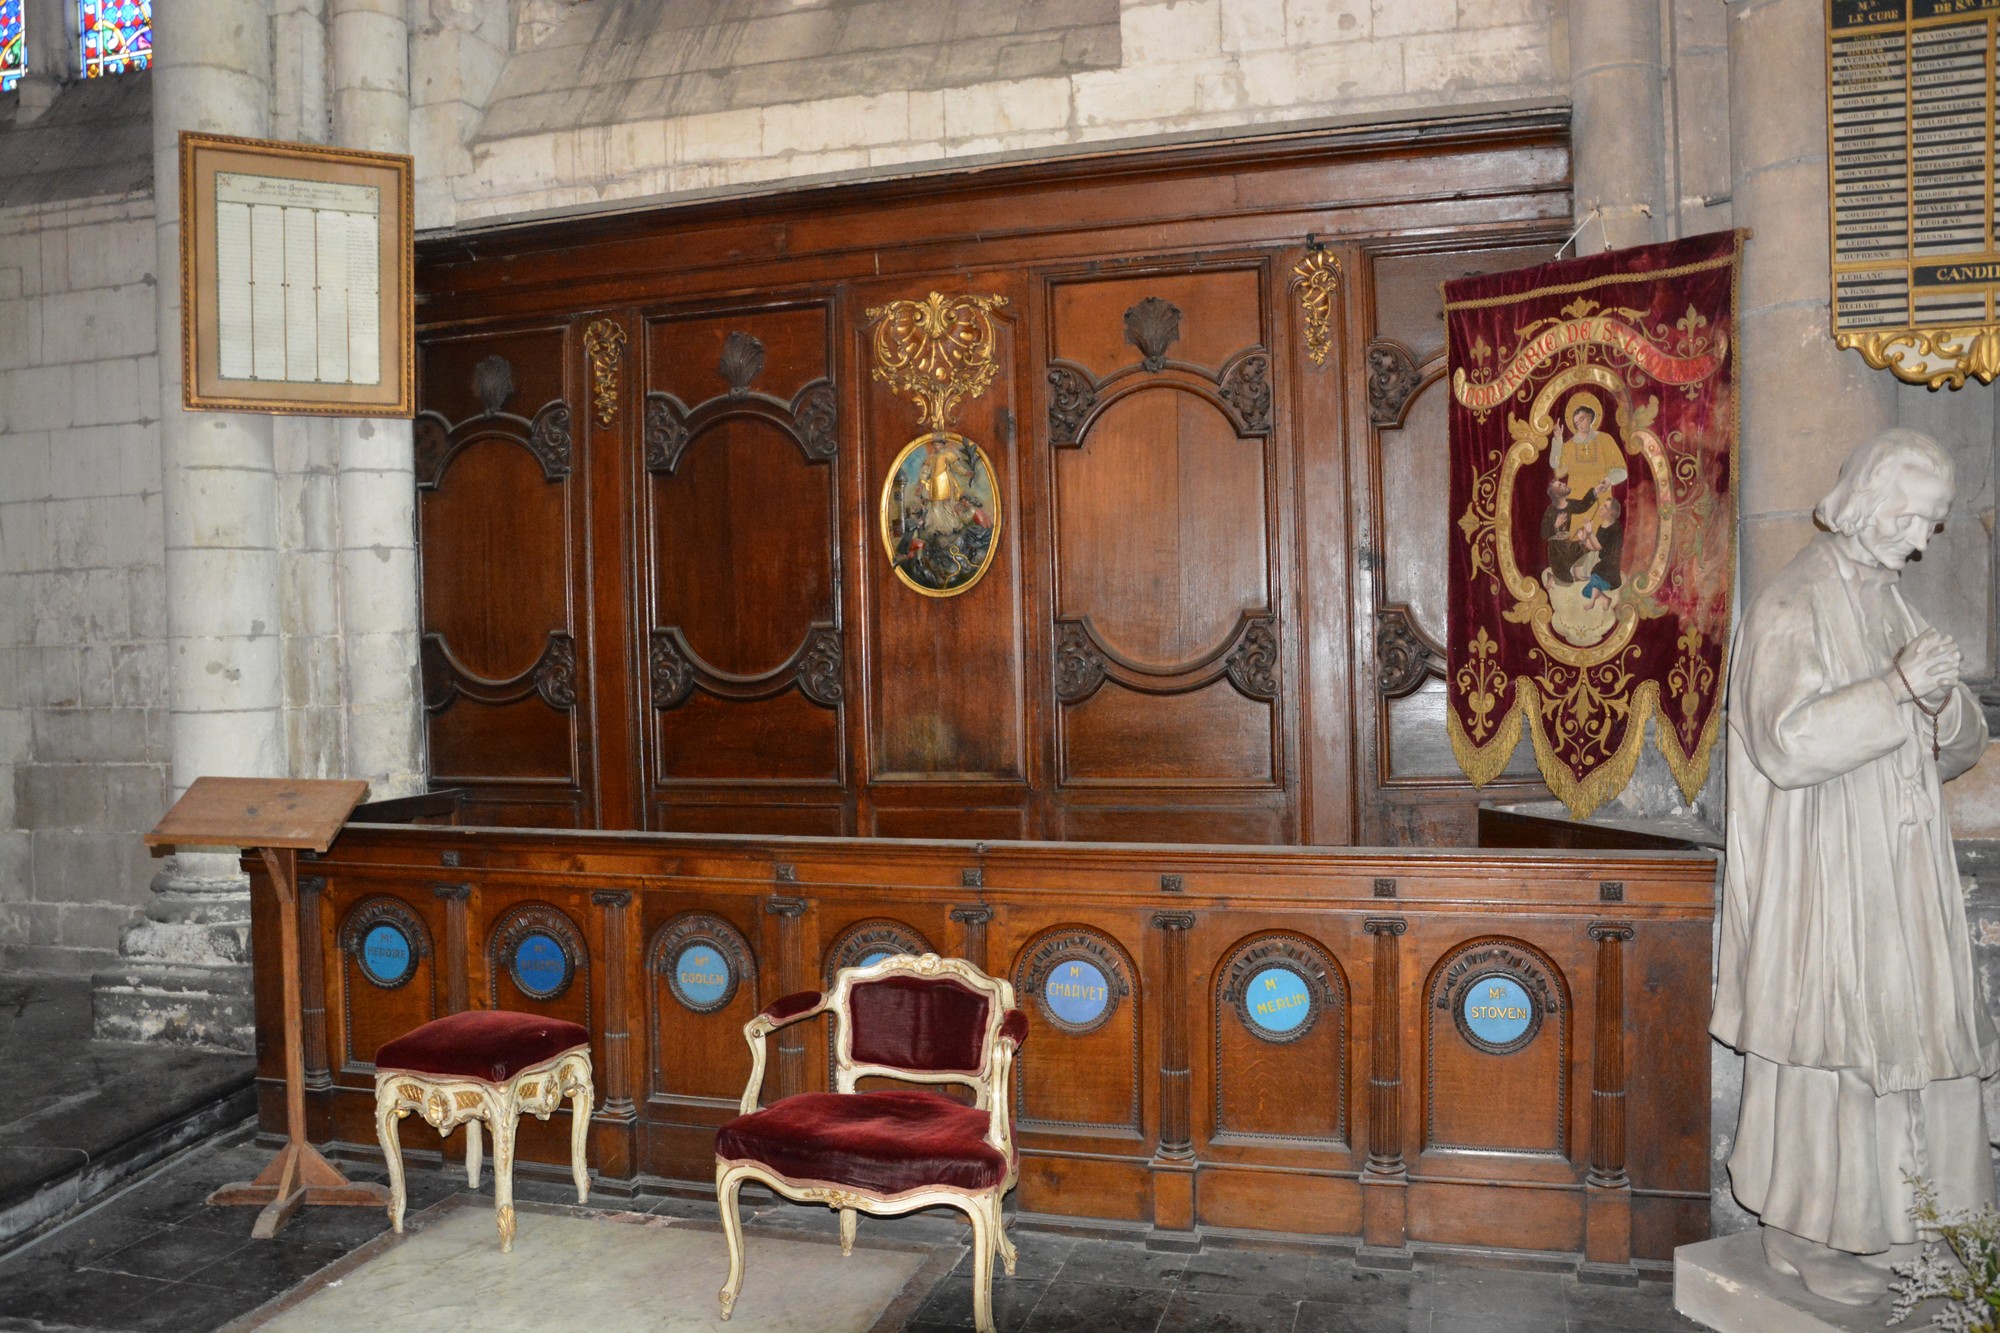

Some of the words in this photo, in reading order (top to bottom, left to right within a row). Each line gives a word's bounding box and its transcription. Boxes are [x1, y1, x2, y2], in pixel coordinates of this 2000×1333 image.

[1849, 13, 1864, 24] LE
[1566, 321, 1592, 342] DE
[368, 946, 406, 960] HEDOIRE
[681, 972, 724, 985] COOLEN
[1049, 982, 1104, 1001] CHARVET
[1471, 1006, 1527, 1020] STOVEN
